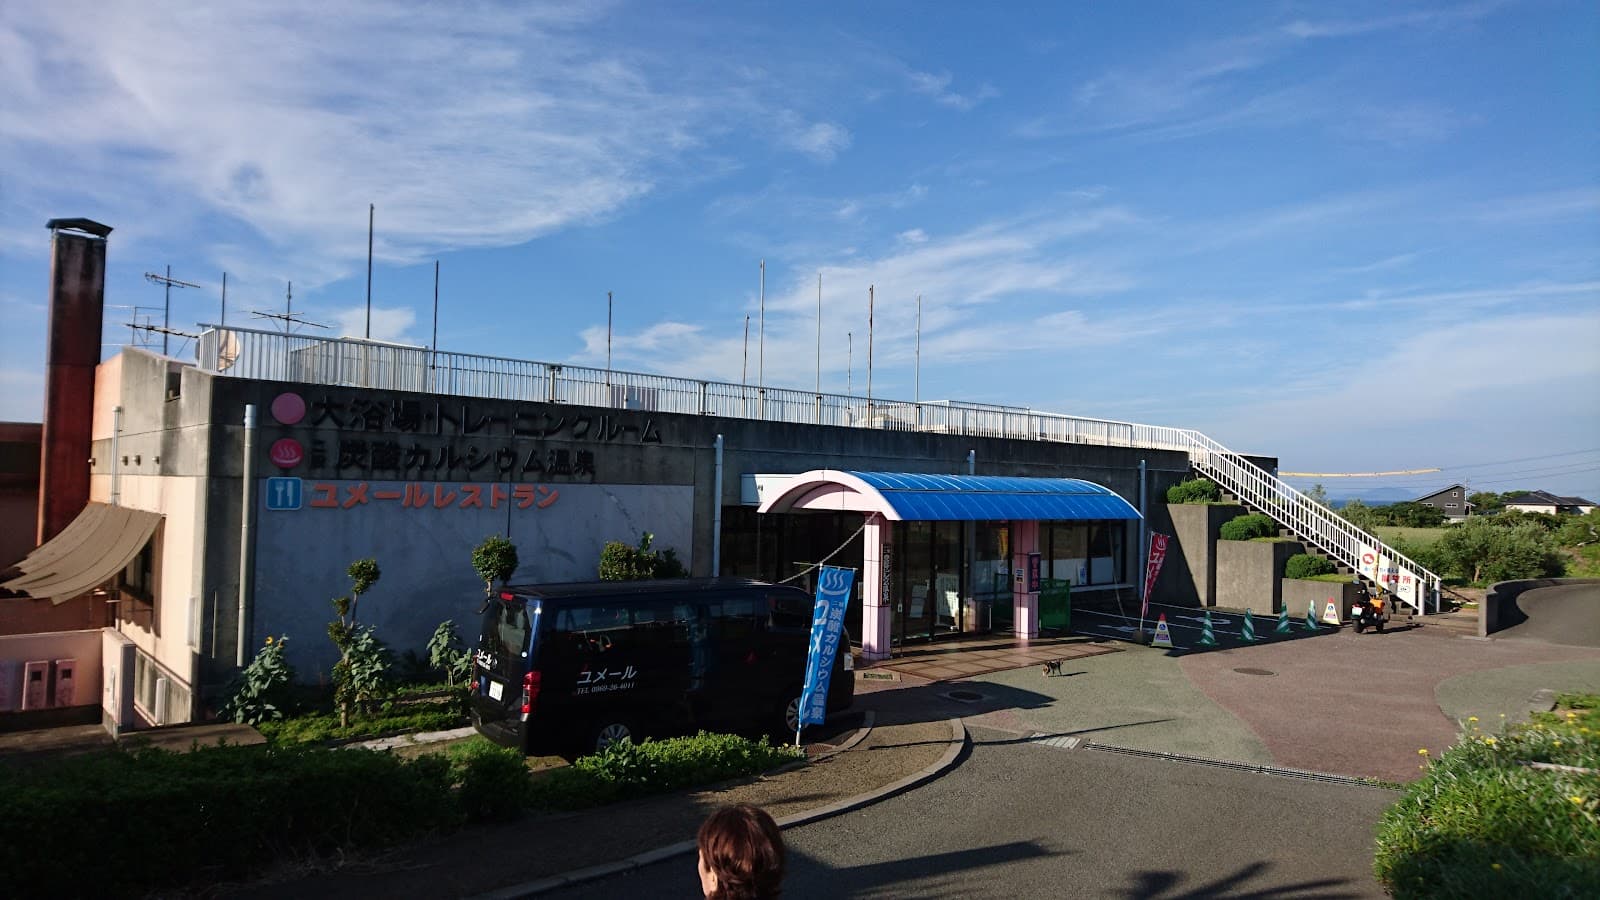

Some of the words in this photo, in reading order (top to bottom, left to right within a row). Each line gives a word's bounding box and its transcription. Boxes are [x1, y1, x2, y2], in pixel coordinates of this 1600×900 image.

[310, 480, 560, 510] ユメールレストラン
[576, 665, 638, 684] ユメール
